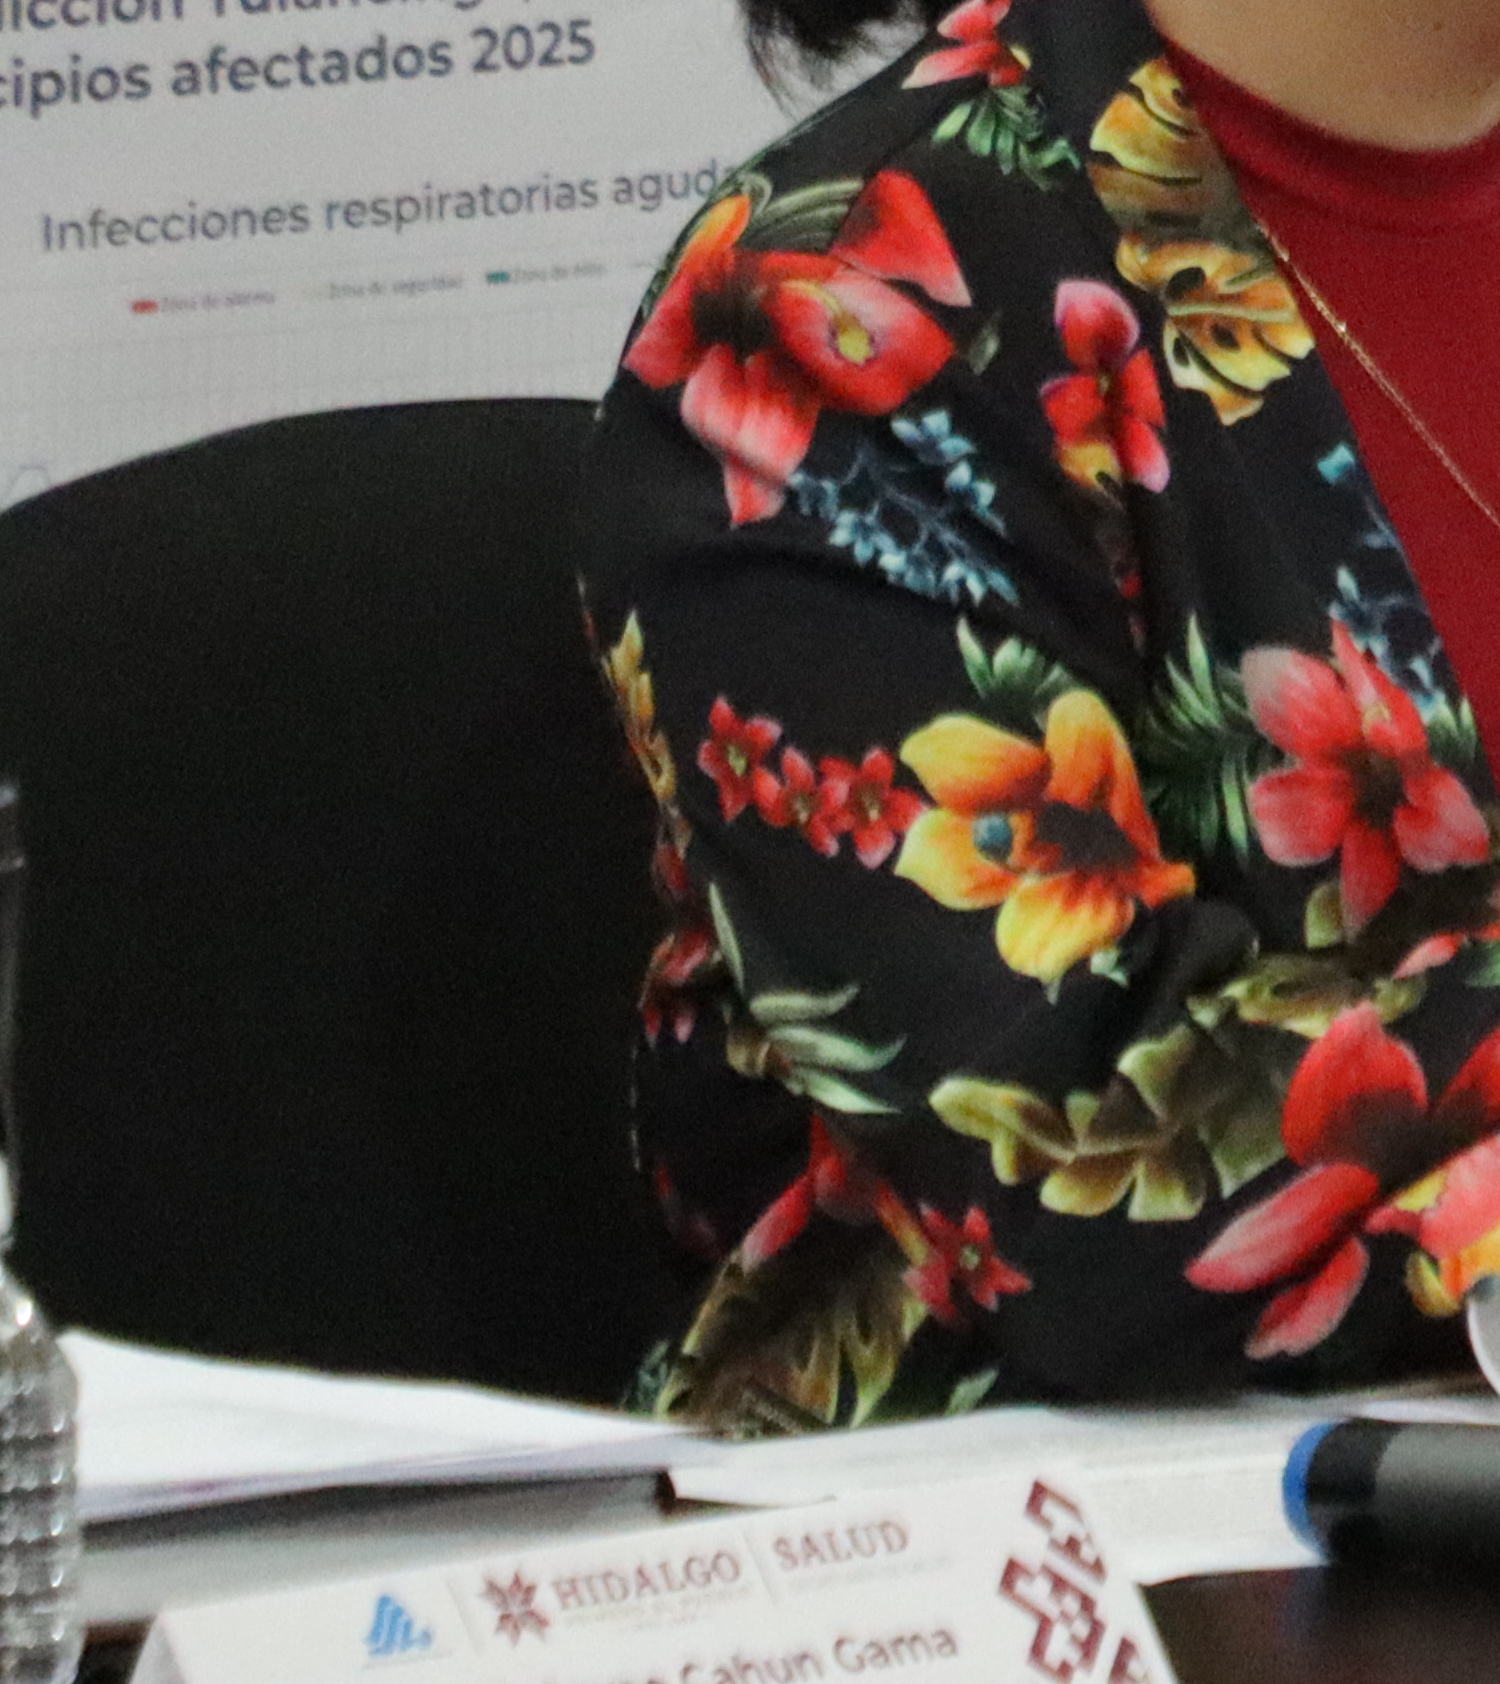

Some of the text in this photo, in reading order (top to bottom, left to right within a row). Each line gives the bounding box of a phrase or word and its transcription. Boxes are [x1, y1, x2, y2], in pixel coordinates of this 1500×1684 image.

[171, 34, 454, 96] afectados
[471, 18, 597, 73] 2025
[41, 201, 311, 251] Infecciones
[324, 182, 600, 231] respiratorias
[551, 1550, 742, 1610] HIDALGO
[772, 1519, 909, 1568] SALUD
